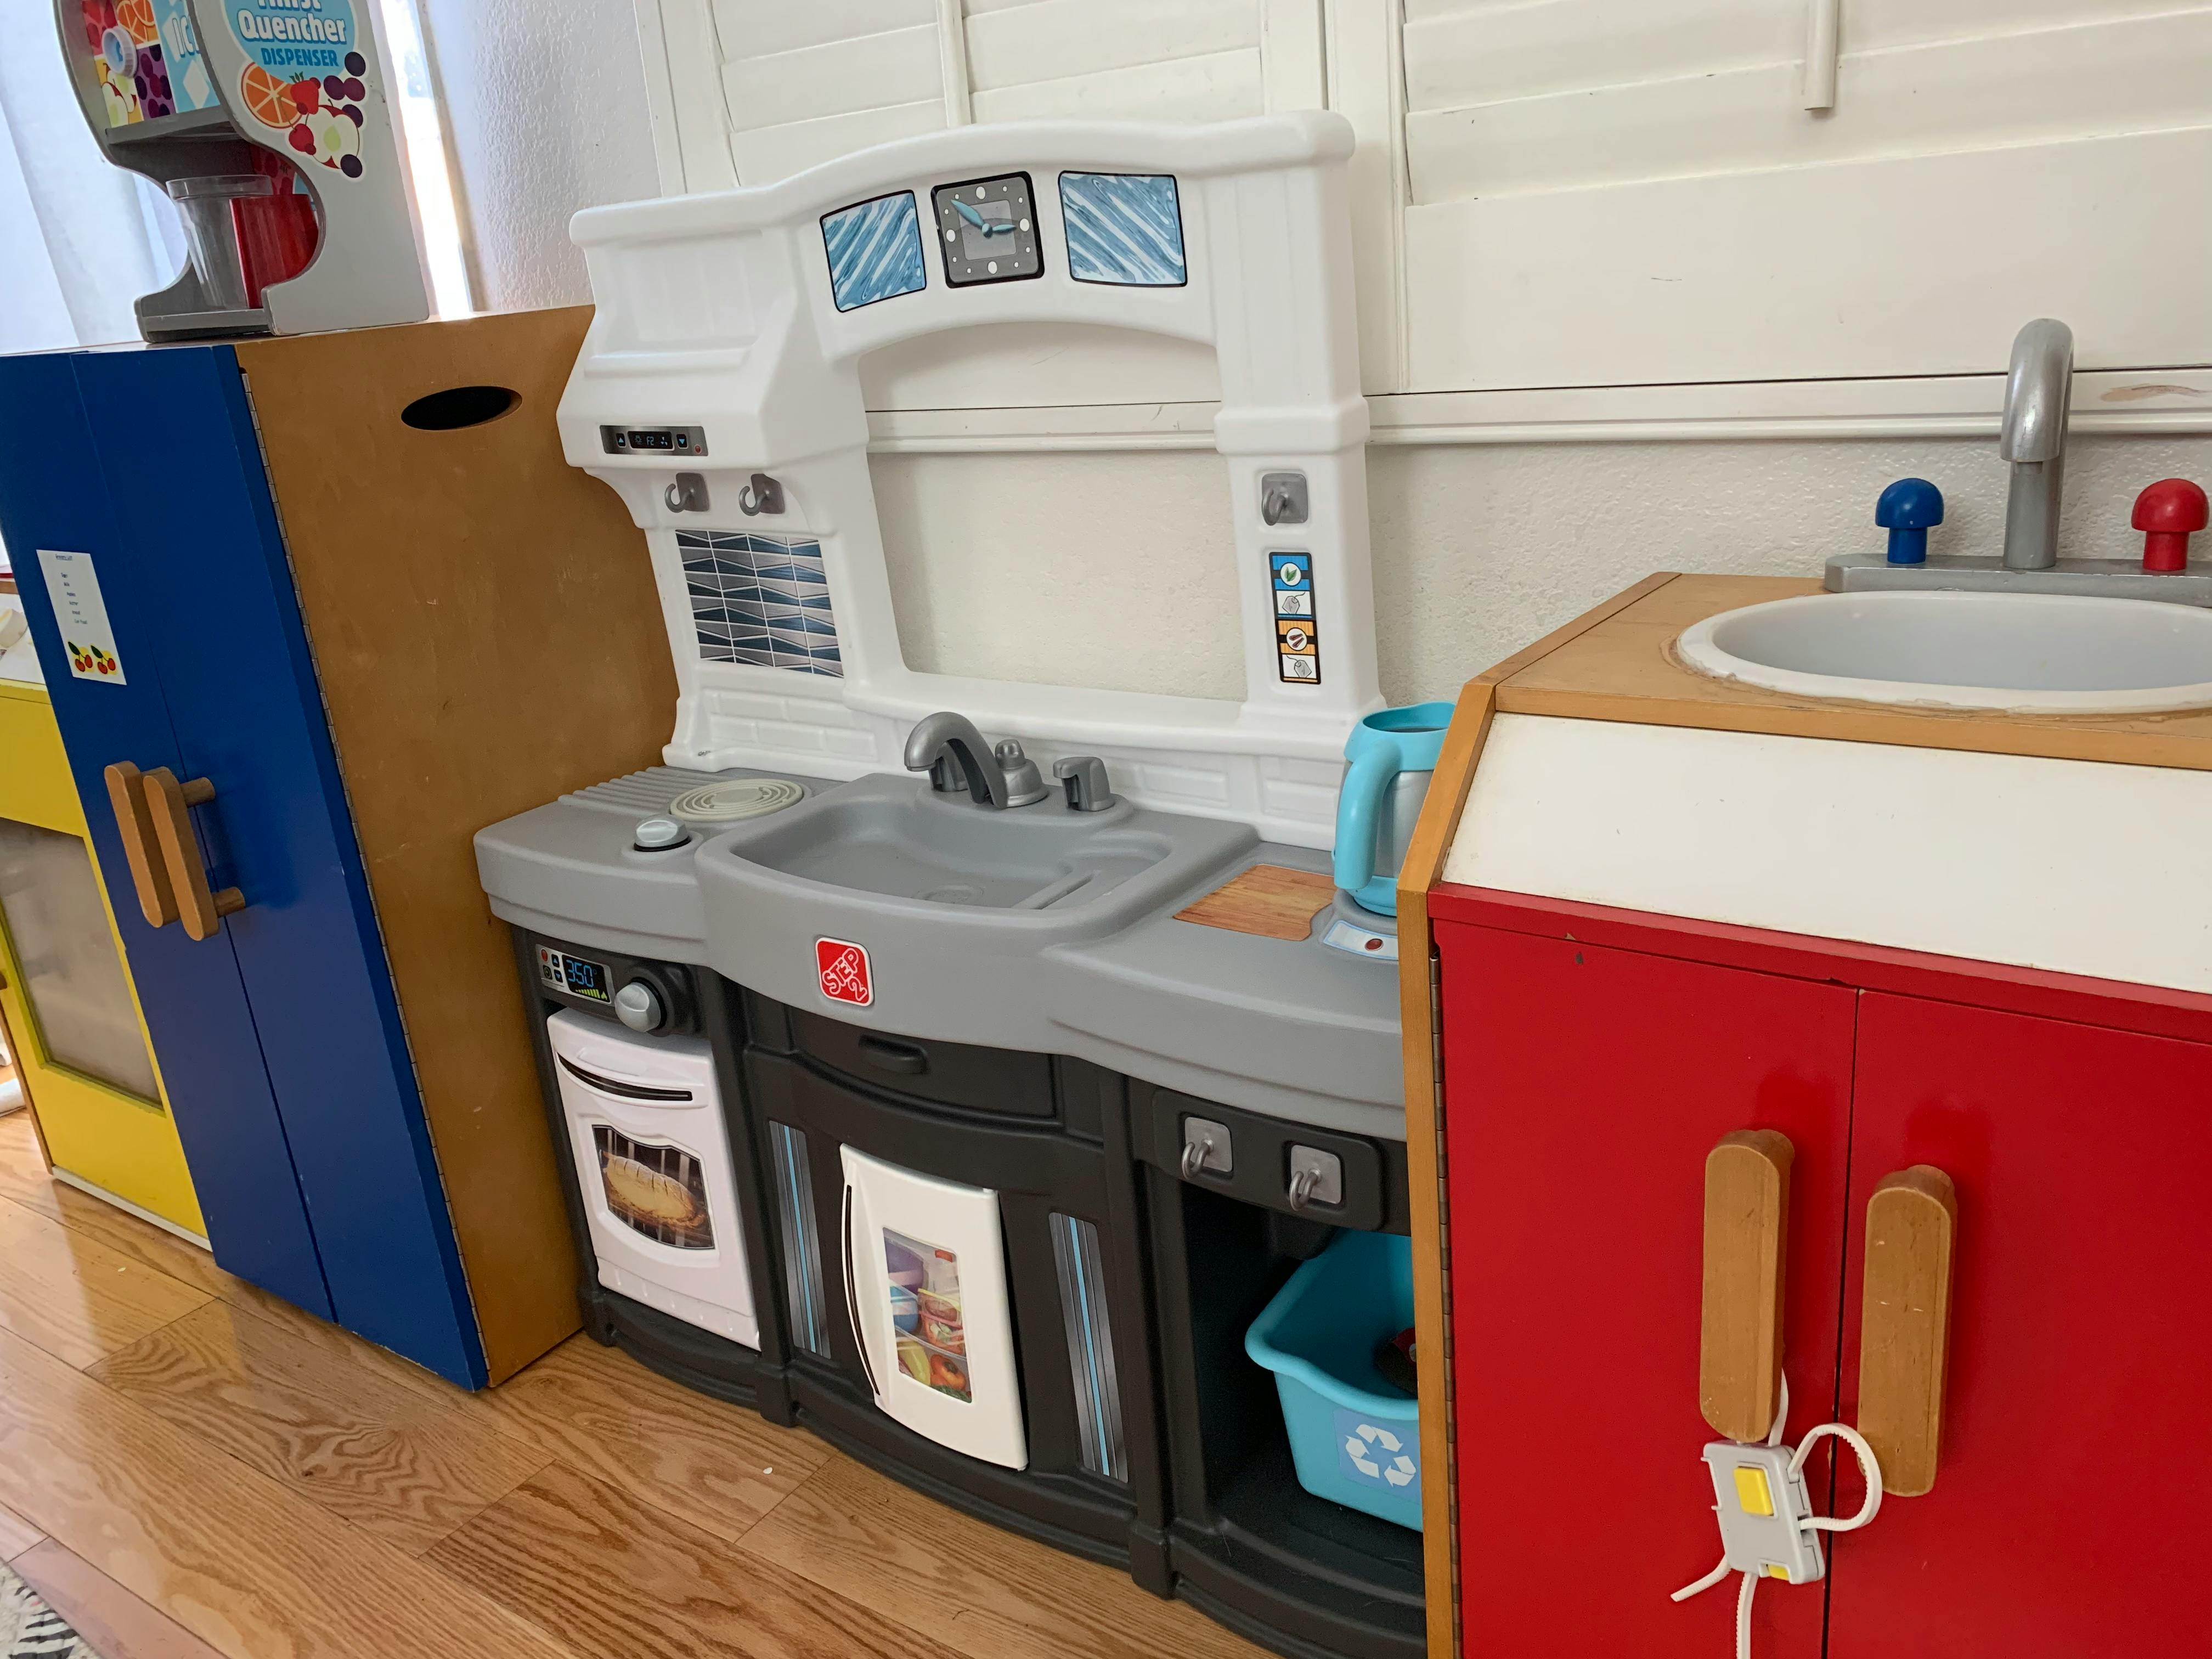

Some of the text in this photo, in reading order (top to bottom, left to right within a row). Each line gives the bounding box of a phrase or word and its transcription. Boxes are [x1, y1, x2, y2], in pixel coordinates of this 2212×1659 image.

[237, 9, 347, 44] Quencher
[261, 48, 339, 66] DISPENSER
[822, 947, 859, 995] STEP
